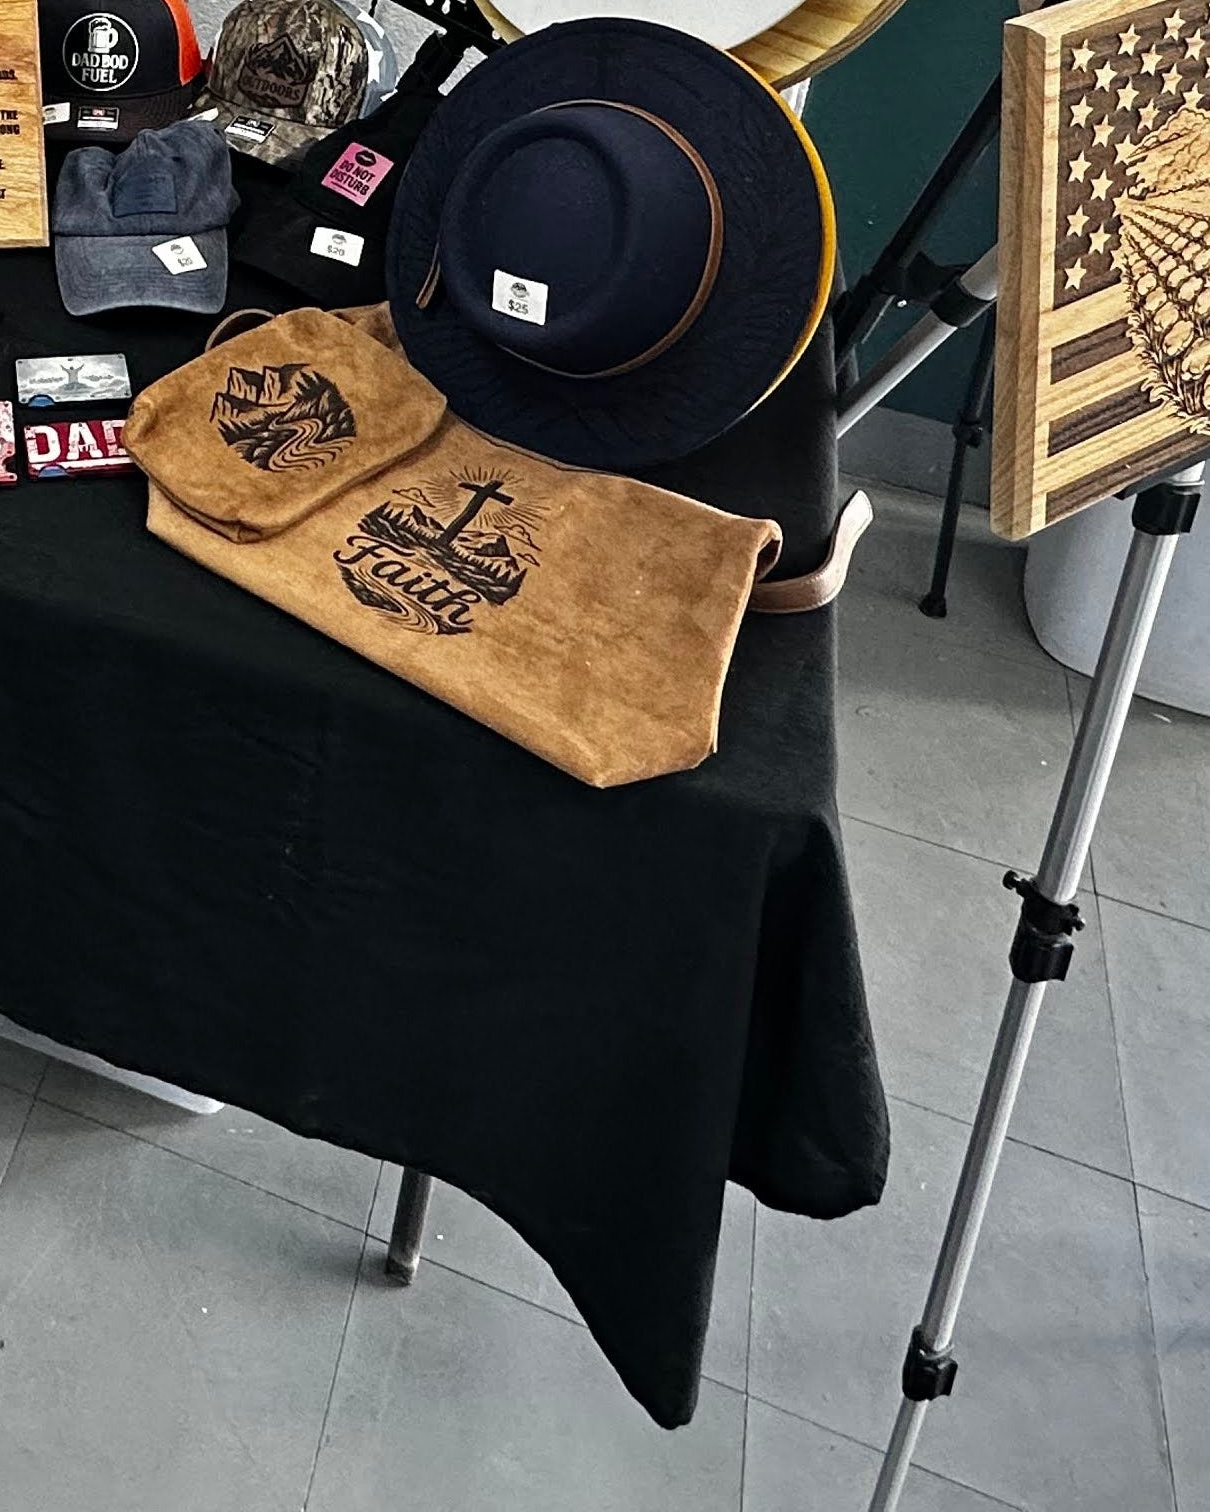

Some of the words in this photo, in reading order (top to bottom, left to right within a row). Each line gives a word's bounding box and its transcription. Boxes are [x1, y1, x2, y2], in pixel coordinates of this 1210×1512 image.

[72, 52, 100, 68] DAD
[102, 54, 128, 69] BOD
[82, 69, 117, 84] FUEL
[242, 77, 300, 98] OUTDOORS
[0, 110, 18, 120] THE
[339, 160, 354, 173] DO
[351, 167, 375, 183] NOT
[328, 169, 371, 196] DISTURB
[508, 300, 529, 314] $25
[333, 533, 485, 626] Faith
